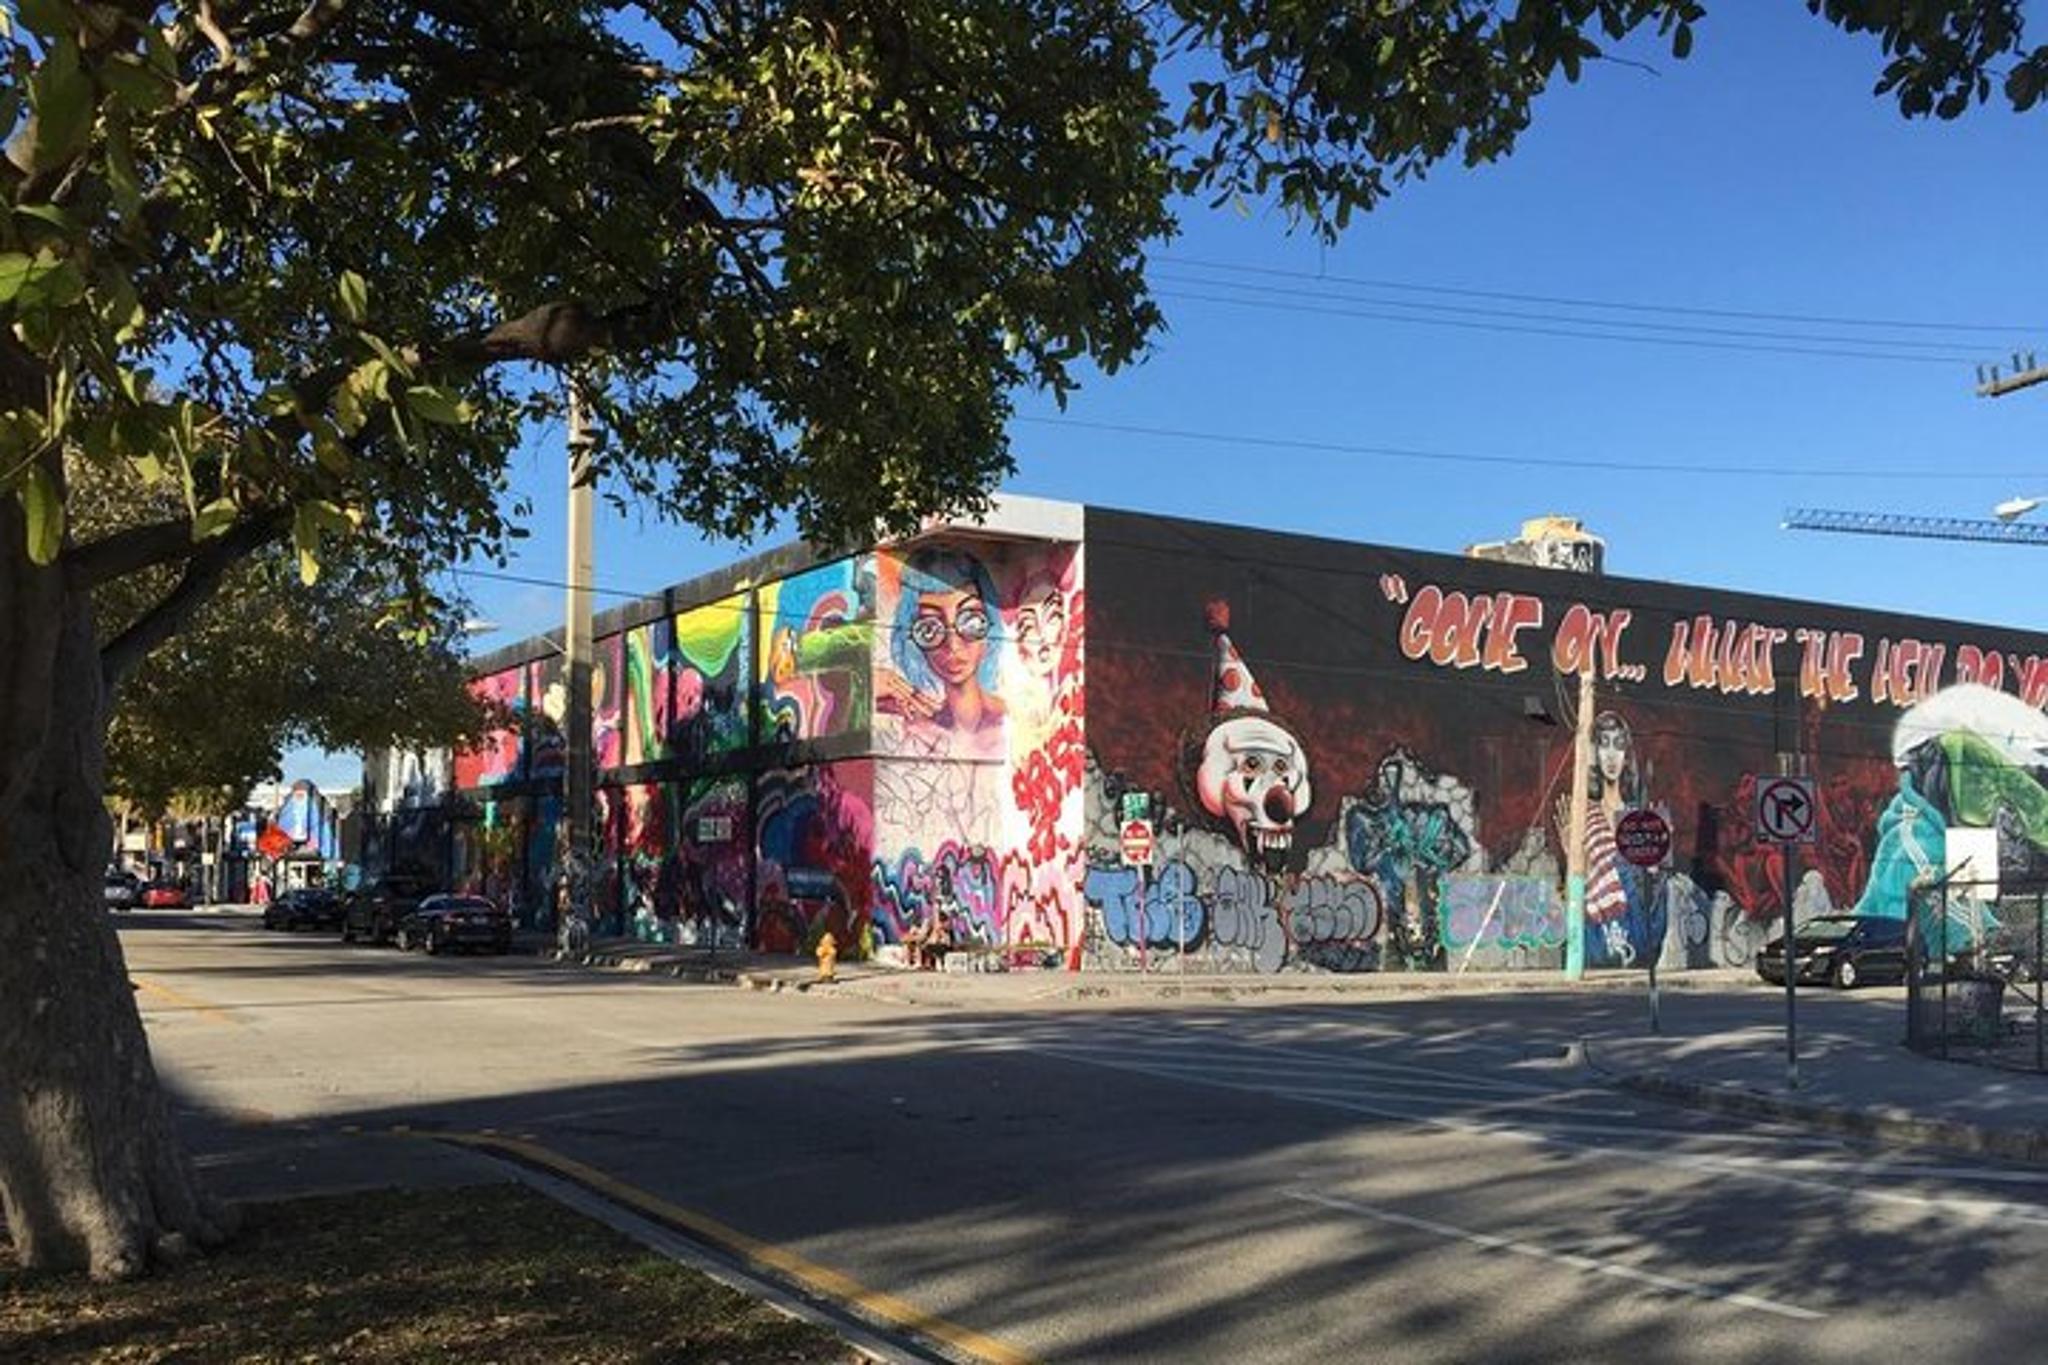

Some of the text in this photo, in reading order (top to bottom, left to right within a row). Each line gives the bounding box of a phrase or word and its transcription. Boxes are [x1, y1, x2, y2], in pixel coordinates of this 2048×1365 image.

[1664, 614, 1787, 694] WHAT
[1795, 628, 1864, 703] THE
[1871, 637, 1943, 708] HELL
